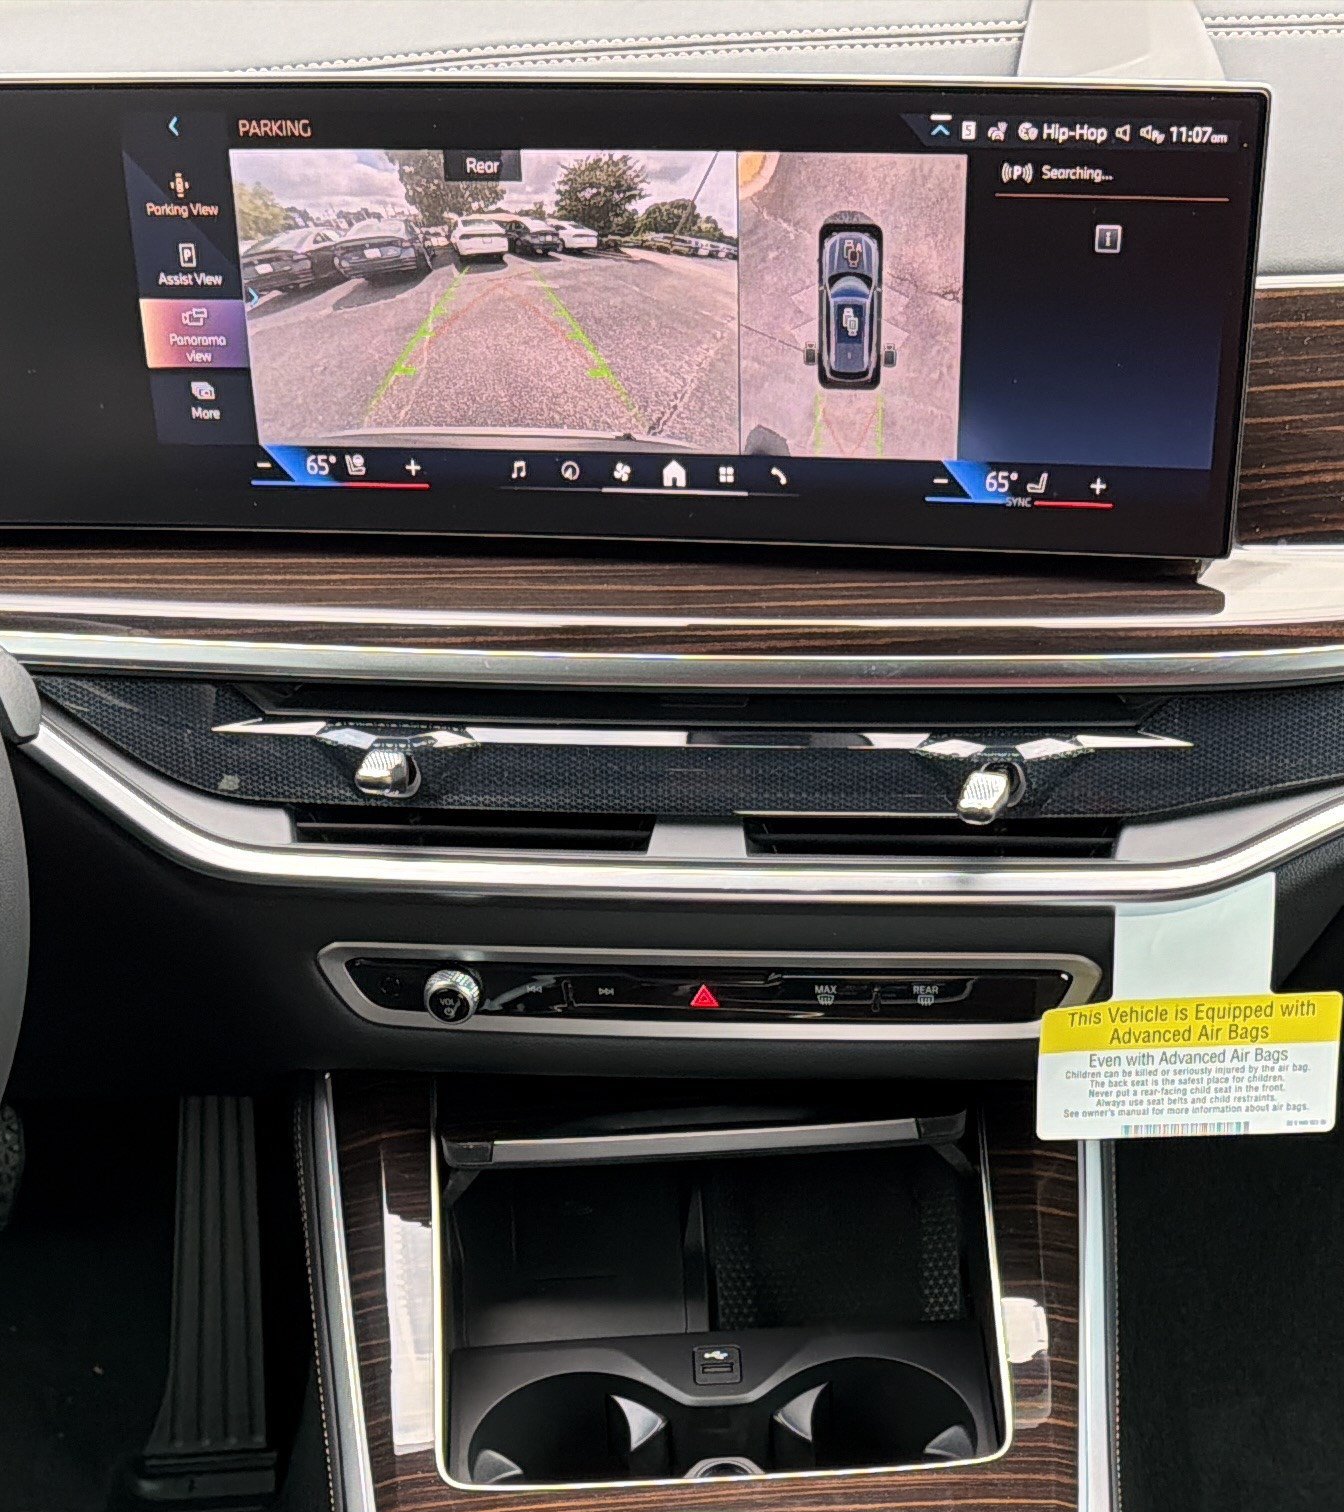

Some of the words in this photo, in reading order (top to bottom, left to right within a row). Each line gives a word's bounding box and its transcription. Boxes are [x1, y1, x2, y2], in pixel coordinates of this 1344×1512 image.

[237, 120, 311, 138] PARKING
[1043, 123, 1107, 144] Hip-Hop
[466, 157, 500, 175] Rear
[146, 203, 189, 218] Parking
[190, 203, 219, 216] View
[158, 272, 193, 286] Assist
[194, 273, 223, 286] View
[169, 333, 226, 346] Panorama
[186, 350, 212, 362] view
[191, 407, 220, 420] More
[1005, 497, 1032, 508] SYNC
[814, 984, 838, 994] MAX
[912, 985, 939, 995] REAR
[1067, 1011, 1102, 1027] This
[1108, 1005, 1169, 1024] Vehicle
[1175, 1003, 1188, 1021] is
[1194, 1001, 1274, 1023] Equipped
[1280, 1000, 1316, 1017] with
[1109, 1025, 1191, 1046] Advanced
[1197, 1024, 1222, 1041] Air
[1228, 1023, 1270, 1043] Bags
[1089, 1053, 1121, 1068] Even
[1126, 1051, 1154, 1066] with
[1159, 1048, 1226, 1066] Advanced
[1230, 1048, 1250, 1064] Air
[1254, 1047, 1289, 1064] Bags
[1065, 1069, 1101, 1079] Children
[1103, 1070, 1119, 1078] can
[1122, 1069, 1133, 1077] be
[1135, 1068, 1158, 1077] killed
[1161, 1068, 1170, 1076] or
[1173, 1066, 1212, 1076] seriously
[1215, 1064, 1246, 1074] injured
[1249, 1064, 1259, 1074] by
[1261, 1064, 1275, 1073] the
[1278, 1063, 1290, 1072] air
[1090, 1079, 1105, 1088] The
[1108, 1079, 1128, 1088] back
[1131, 1078, 1149, 1087] seat
[1152, 1078, 1159, 1086] is
[1161, 1077, 1175, 1086] the
[1178, 1076, 1204, 1085] safest
[1206, 1075, 1229, 1085] place
[1232, 1075, 1244, 1083] for
[1088, 1089, 1113, 1098] Never
[1116, 1088, 1130, 1098] put
[1140, 1087, 1187, 1097] rear-facing
[1190, 1086, 1211, 1095] child
[1214, 1085, 1232, 1094] seat
[1235, 1085, 1242, 1093] in
[1245, 1084, 1259, 1092] the
[1096, 1099, 1126, 1108] Always
[1128, 1099, 1144, 1107] use
[1146, 1097, 1164, 1106] seat
[1167, 1096, 1188, 1105] belts
[1191, 1096, 1206, 1104] and
[1210, 1095, 1230, 1103] child
[1063, 1109, 1079, 1118] See
[1082, 1107, 1115, 1117] owner's
[1118, 1107, 1149, 1116] manual
[1152, 1107, 1164, 1115] for
[1167, 1106, 1189, 1115] more
[1191, 1105, 1242, 1114] information
[1245, 1104, 1270, 1112] about
[1272, 1103, 1283, 1111] air
